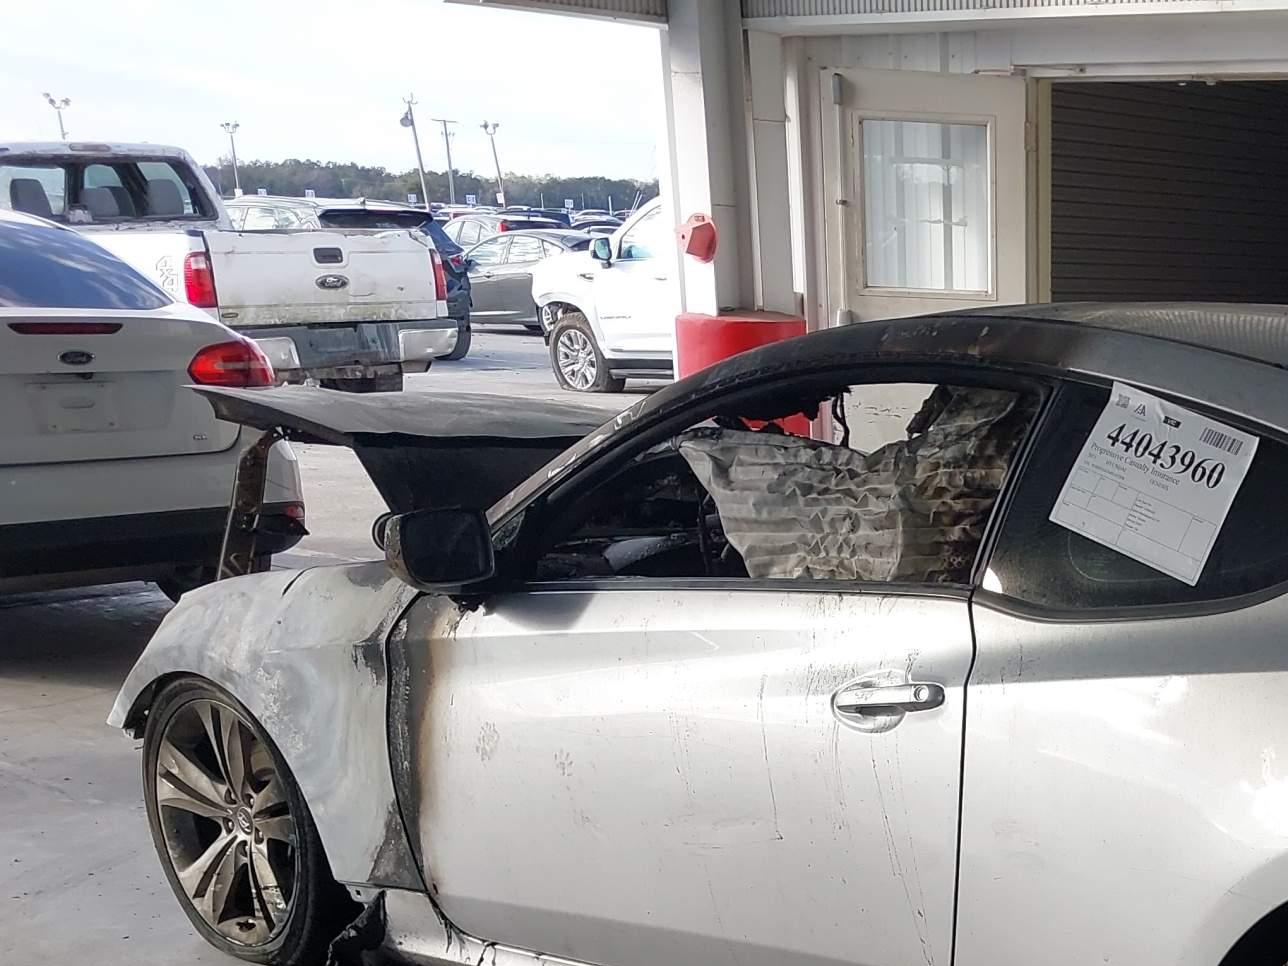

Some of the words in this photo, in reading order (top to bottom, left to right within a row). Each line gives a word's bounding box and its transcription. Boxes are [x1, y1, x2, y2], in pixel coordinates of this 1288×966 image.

[1106, 423, 1226, 489] 44043960
[1125, 454, 1150, 475] Casualty
[1151, 467, 1181, 487] Insurance
